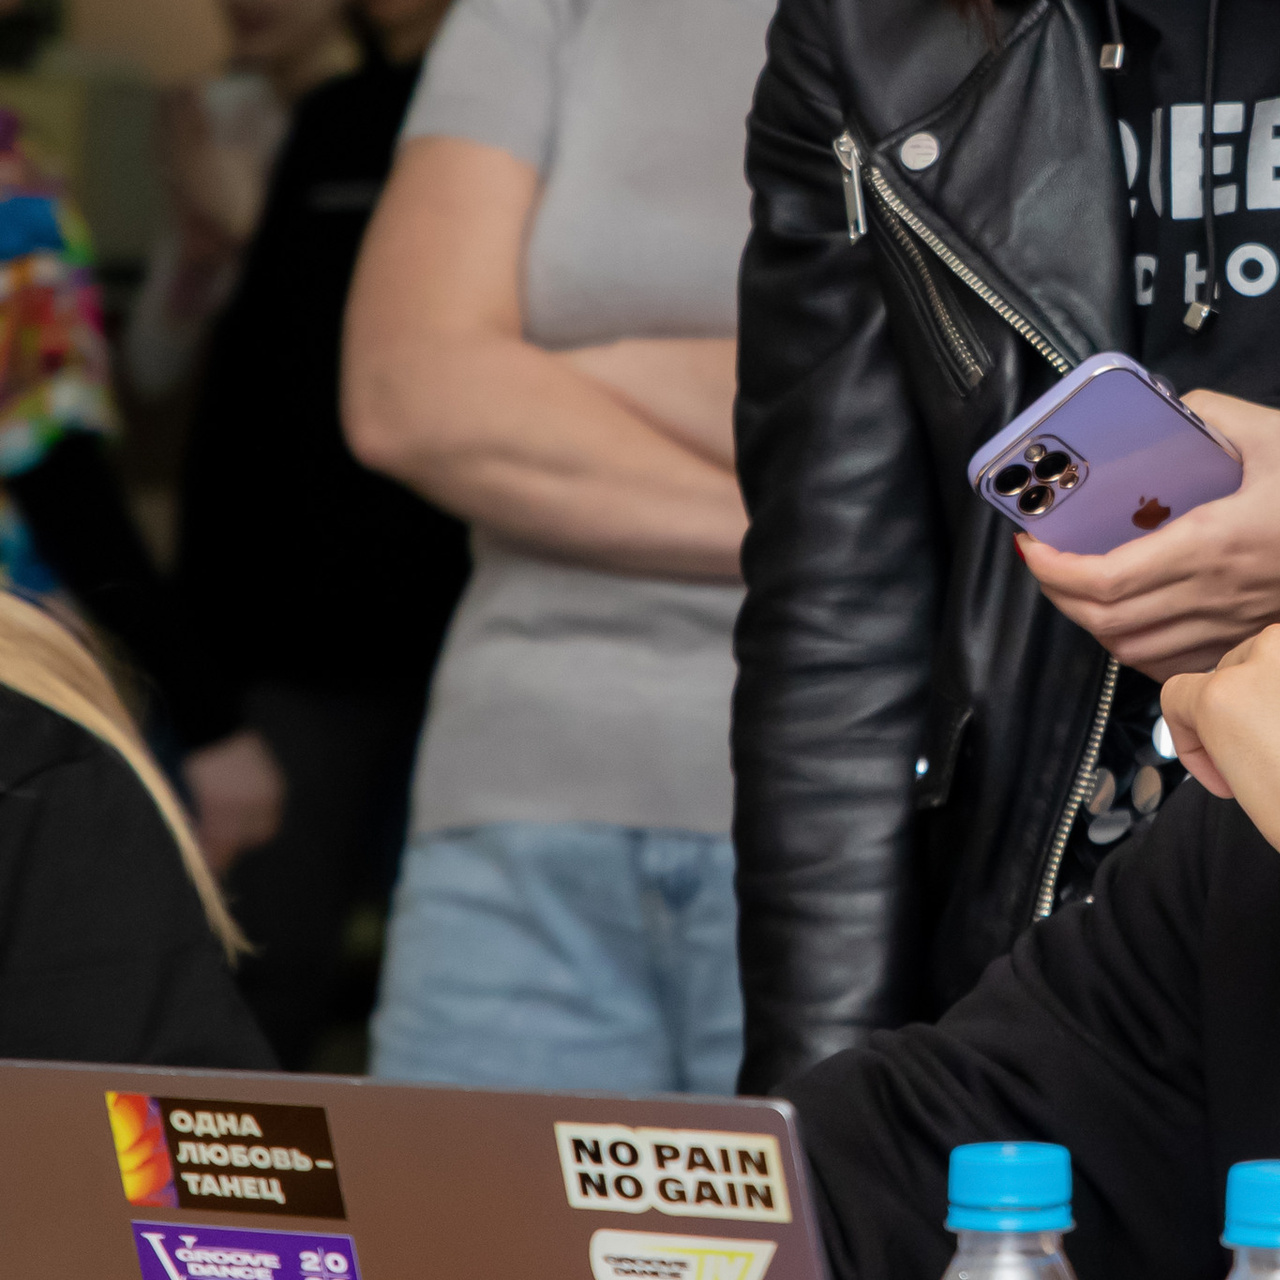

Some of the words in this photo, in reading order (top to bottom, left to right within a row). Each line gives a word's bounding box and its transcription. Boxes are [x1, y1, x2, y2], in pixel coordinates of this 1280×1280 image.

[169, 1110, 262, 1137] ОДНА
[571, 1137, 639, 1167] NO
[653, 1144, 769, 1176] PAIN
[181, 1172, 286, 1204] ТАНЕЦ
[578, 1172, 643, 1200] NO
[658, 1178, 775, 1210] GAIN
